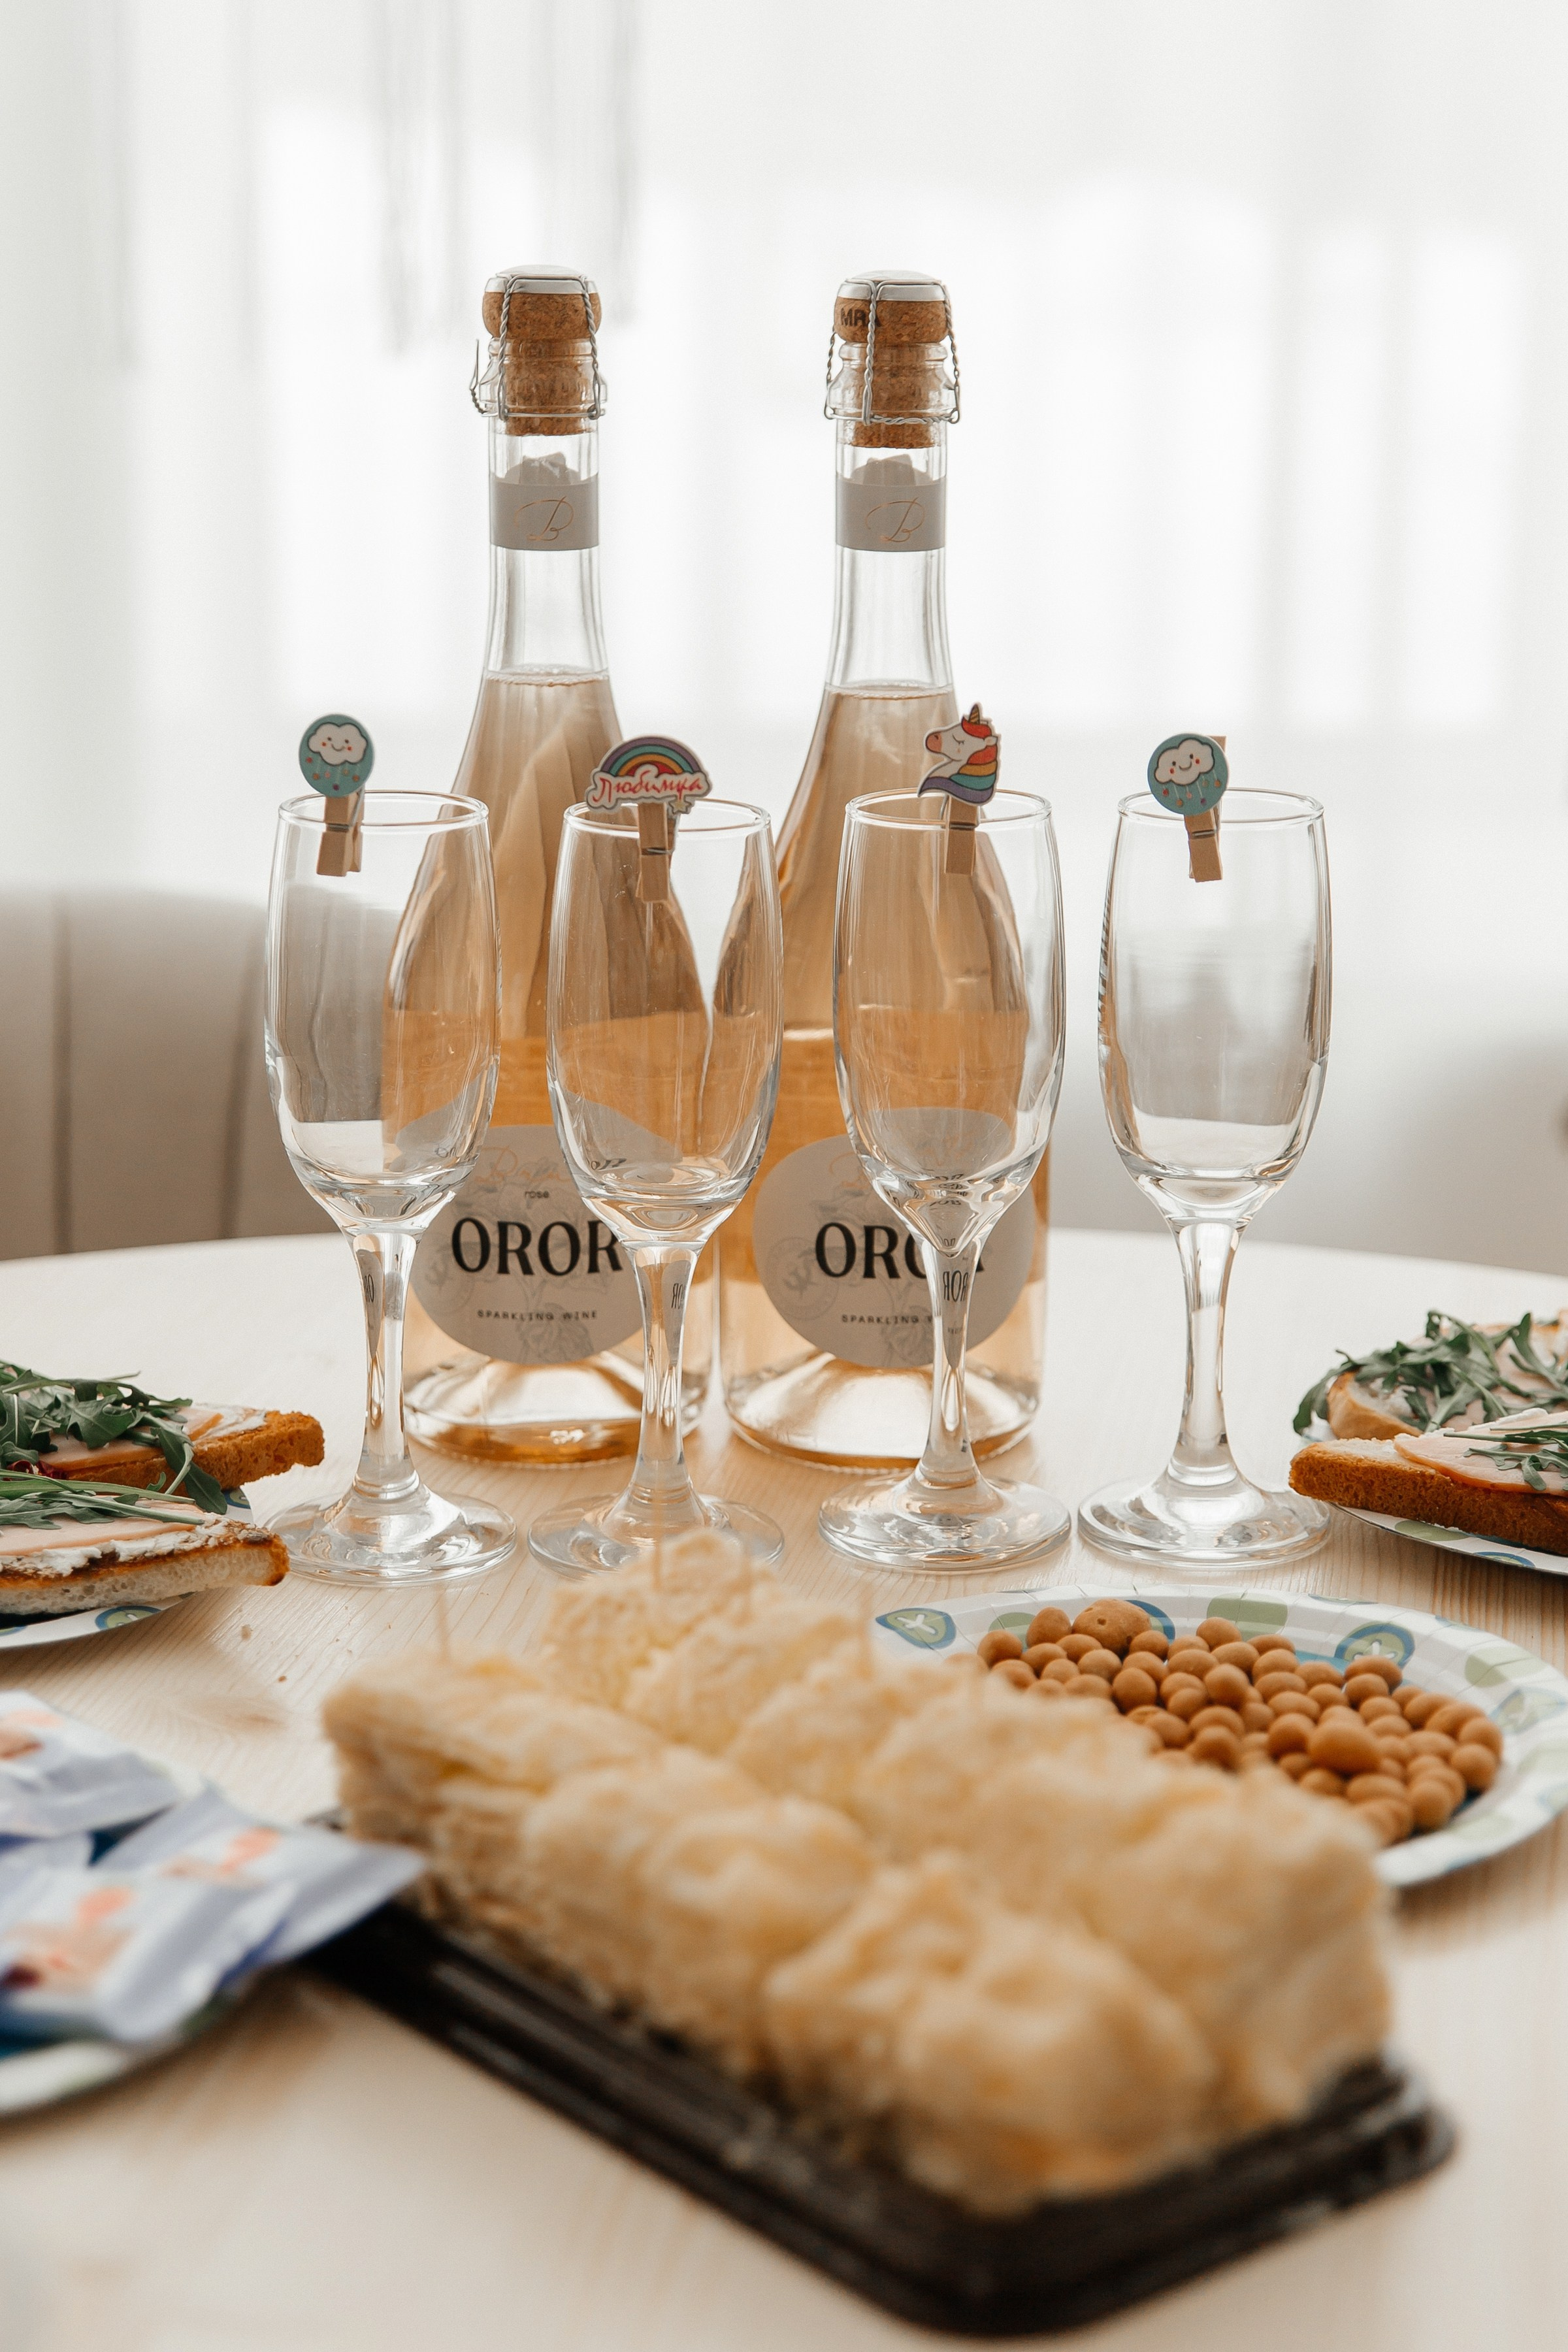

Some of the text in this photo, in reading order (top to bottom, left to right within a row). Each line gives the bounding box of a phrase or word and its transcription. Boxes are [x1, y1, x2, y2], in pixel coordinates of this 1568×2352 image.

[451, 1217, 623, 1276] OROR
[478, 1309, 597, 1321] SPARKLING WINE
[841, 1314, 919, 1324] SPARKLING
